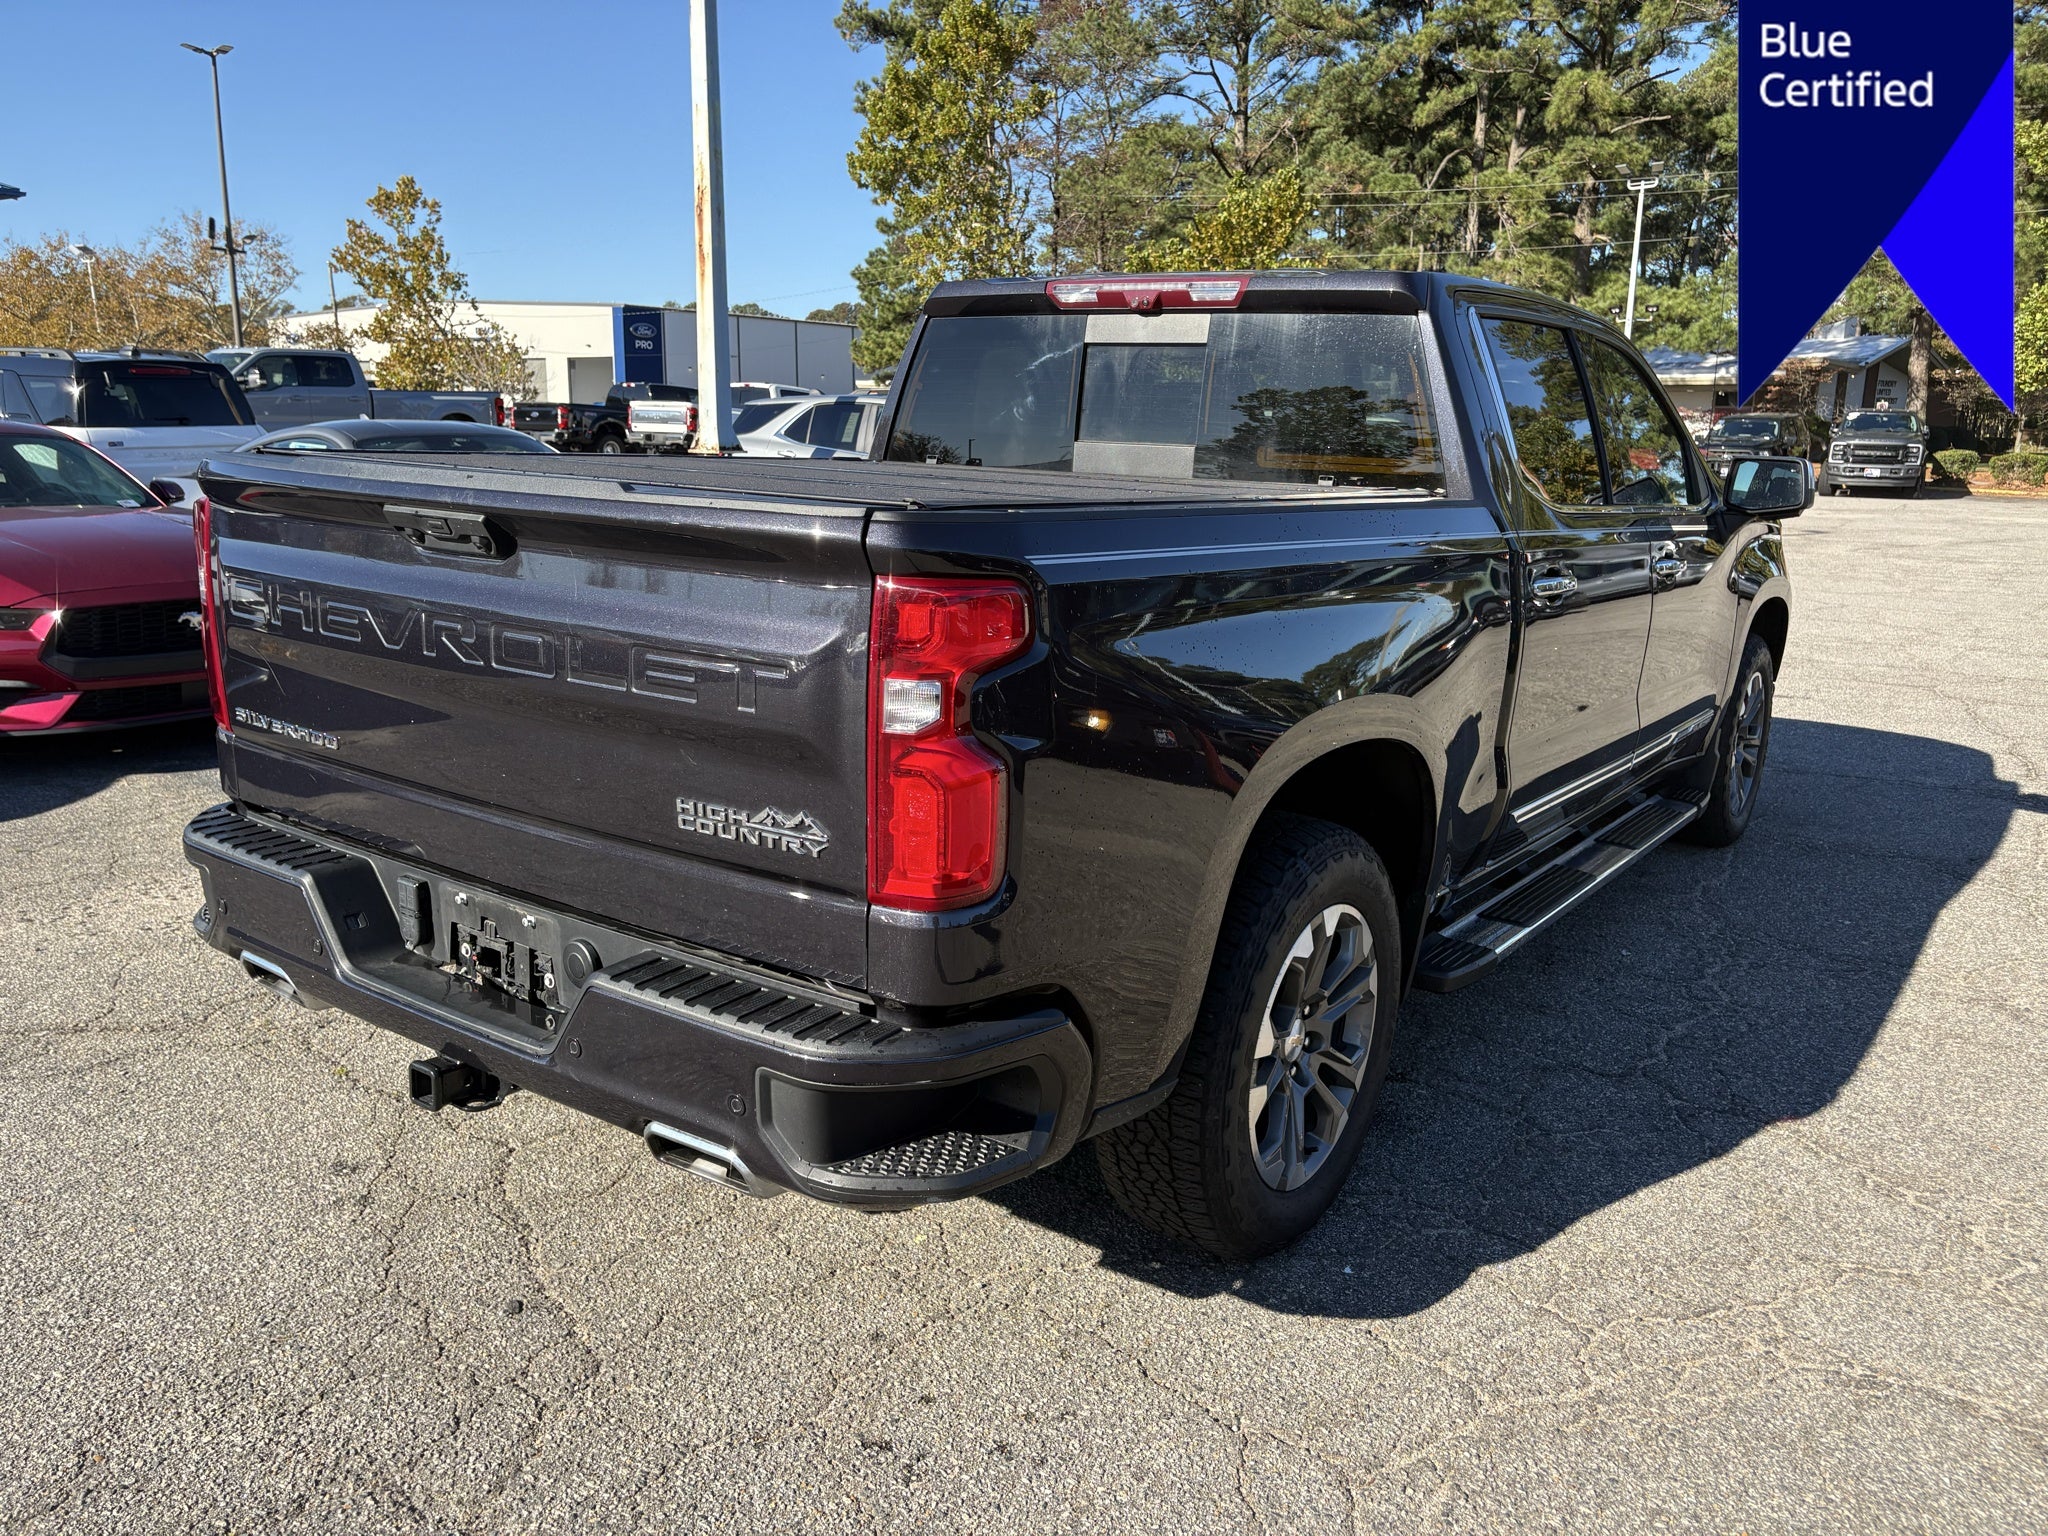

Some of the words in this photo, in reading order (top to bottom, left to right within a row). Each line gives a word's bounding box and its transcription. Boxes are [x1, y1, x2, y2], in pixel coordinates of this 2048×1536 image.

[635, 340, 653, 350] PRO
[228, 573, 789, 713] CHEVROLET
[235, 706, 340, 750] SILVERADO
[676, 797, 750, 826] HIGH
[677, 814, 829, 858] COUNTRY
